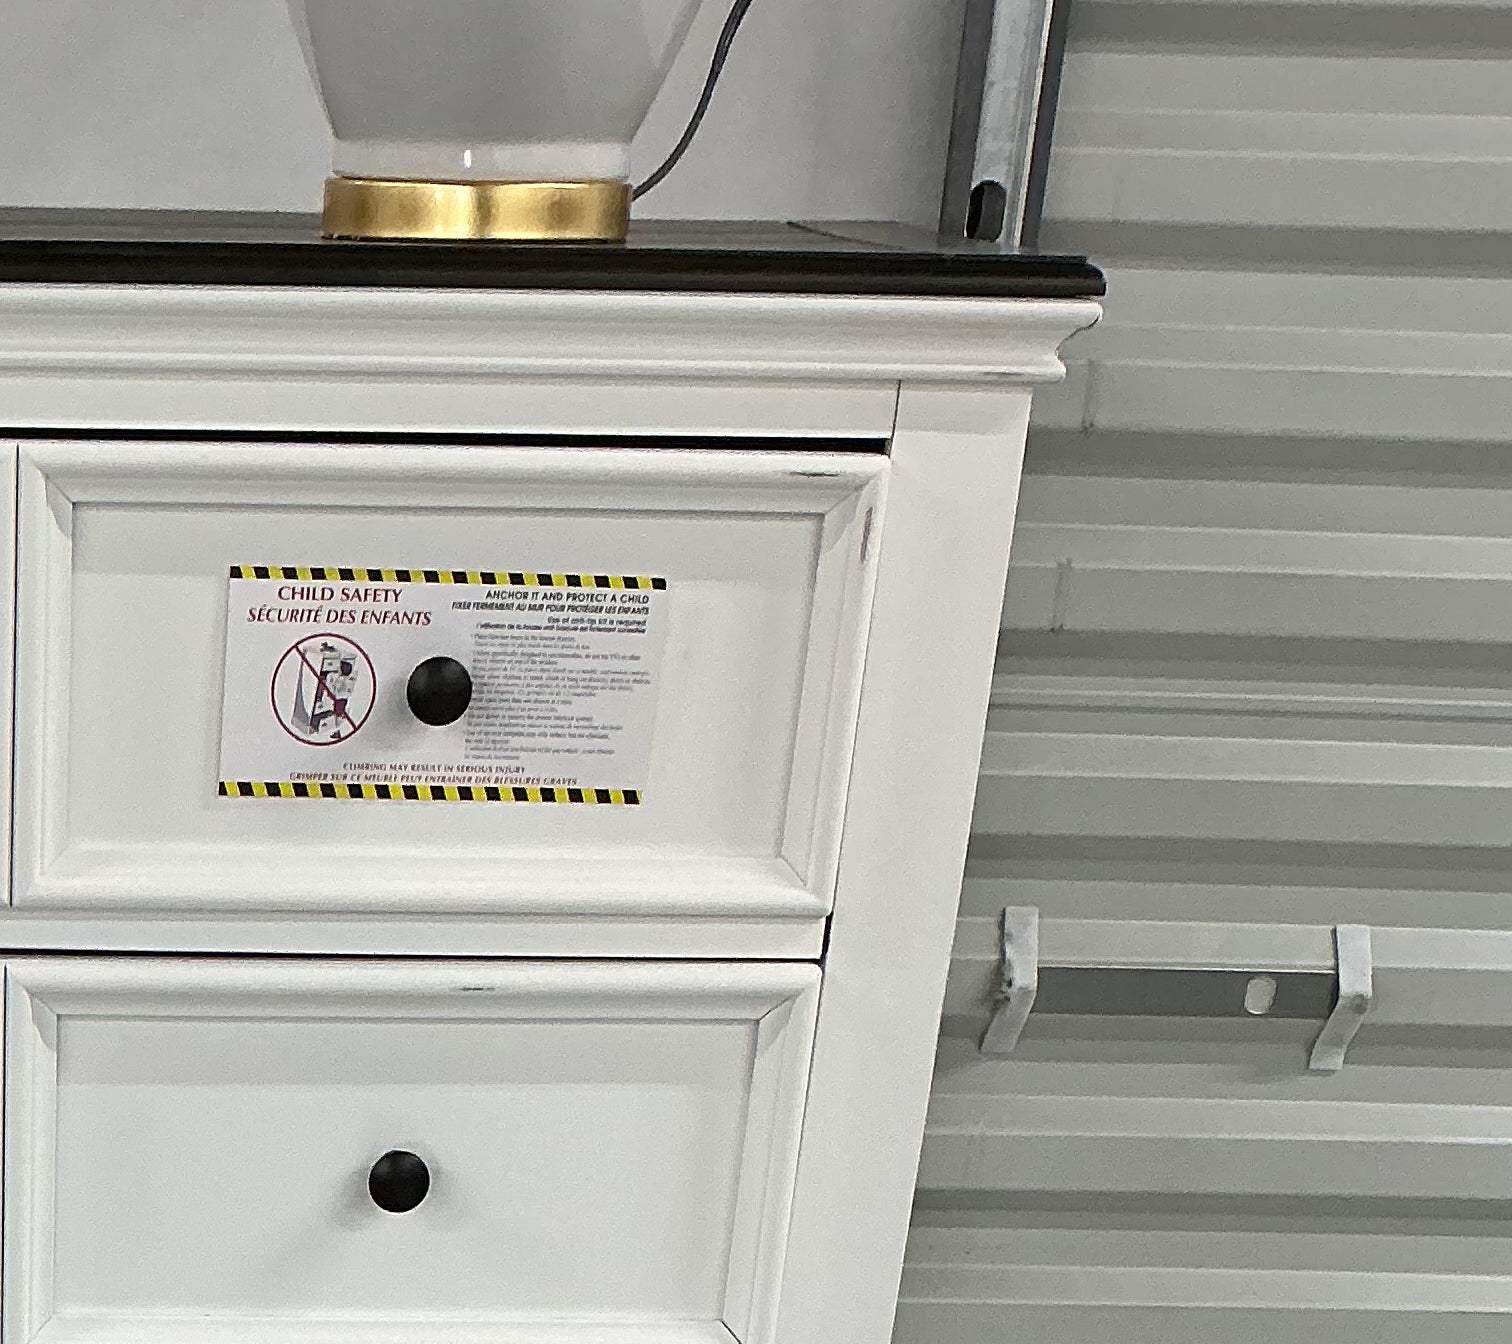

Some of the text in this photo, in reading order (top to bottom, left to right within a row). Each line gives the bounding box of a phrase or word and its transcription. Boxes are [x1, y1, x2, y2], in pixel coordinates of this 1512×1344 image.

[277, 585, 403, 603] CHILD SAFETY
[485, 589, 650, 604] ANCHOR IT AND PROTECT A CHILD
[515, 602, 527, 612] AU
[545, 603, 566, 613] POUR
[247, 604, 433, 627] SÉCURITÉ DES ENFANTS
[389, 763, 409, 772] MAY
[443, 764, 454, 773] IN
[455, 764, 493, 774] SERIOUS
[495, 765, 526, 775] INJURY
[330, 772, 348, 781] SUR
[474, 775, 491, 784] DES
